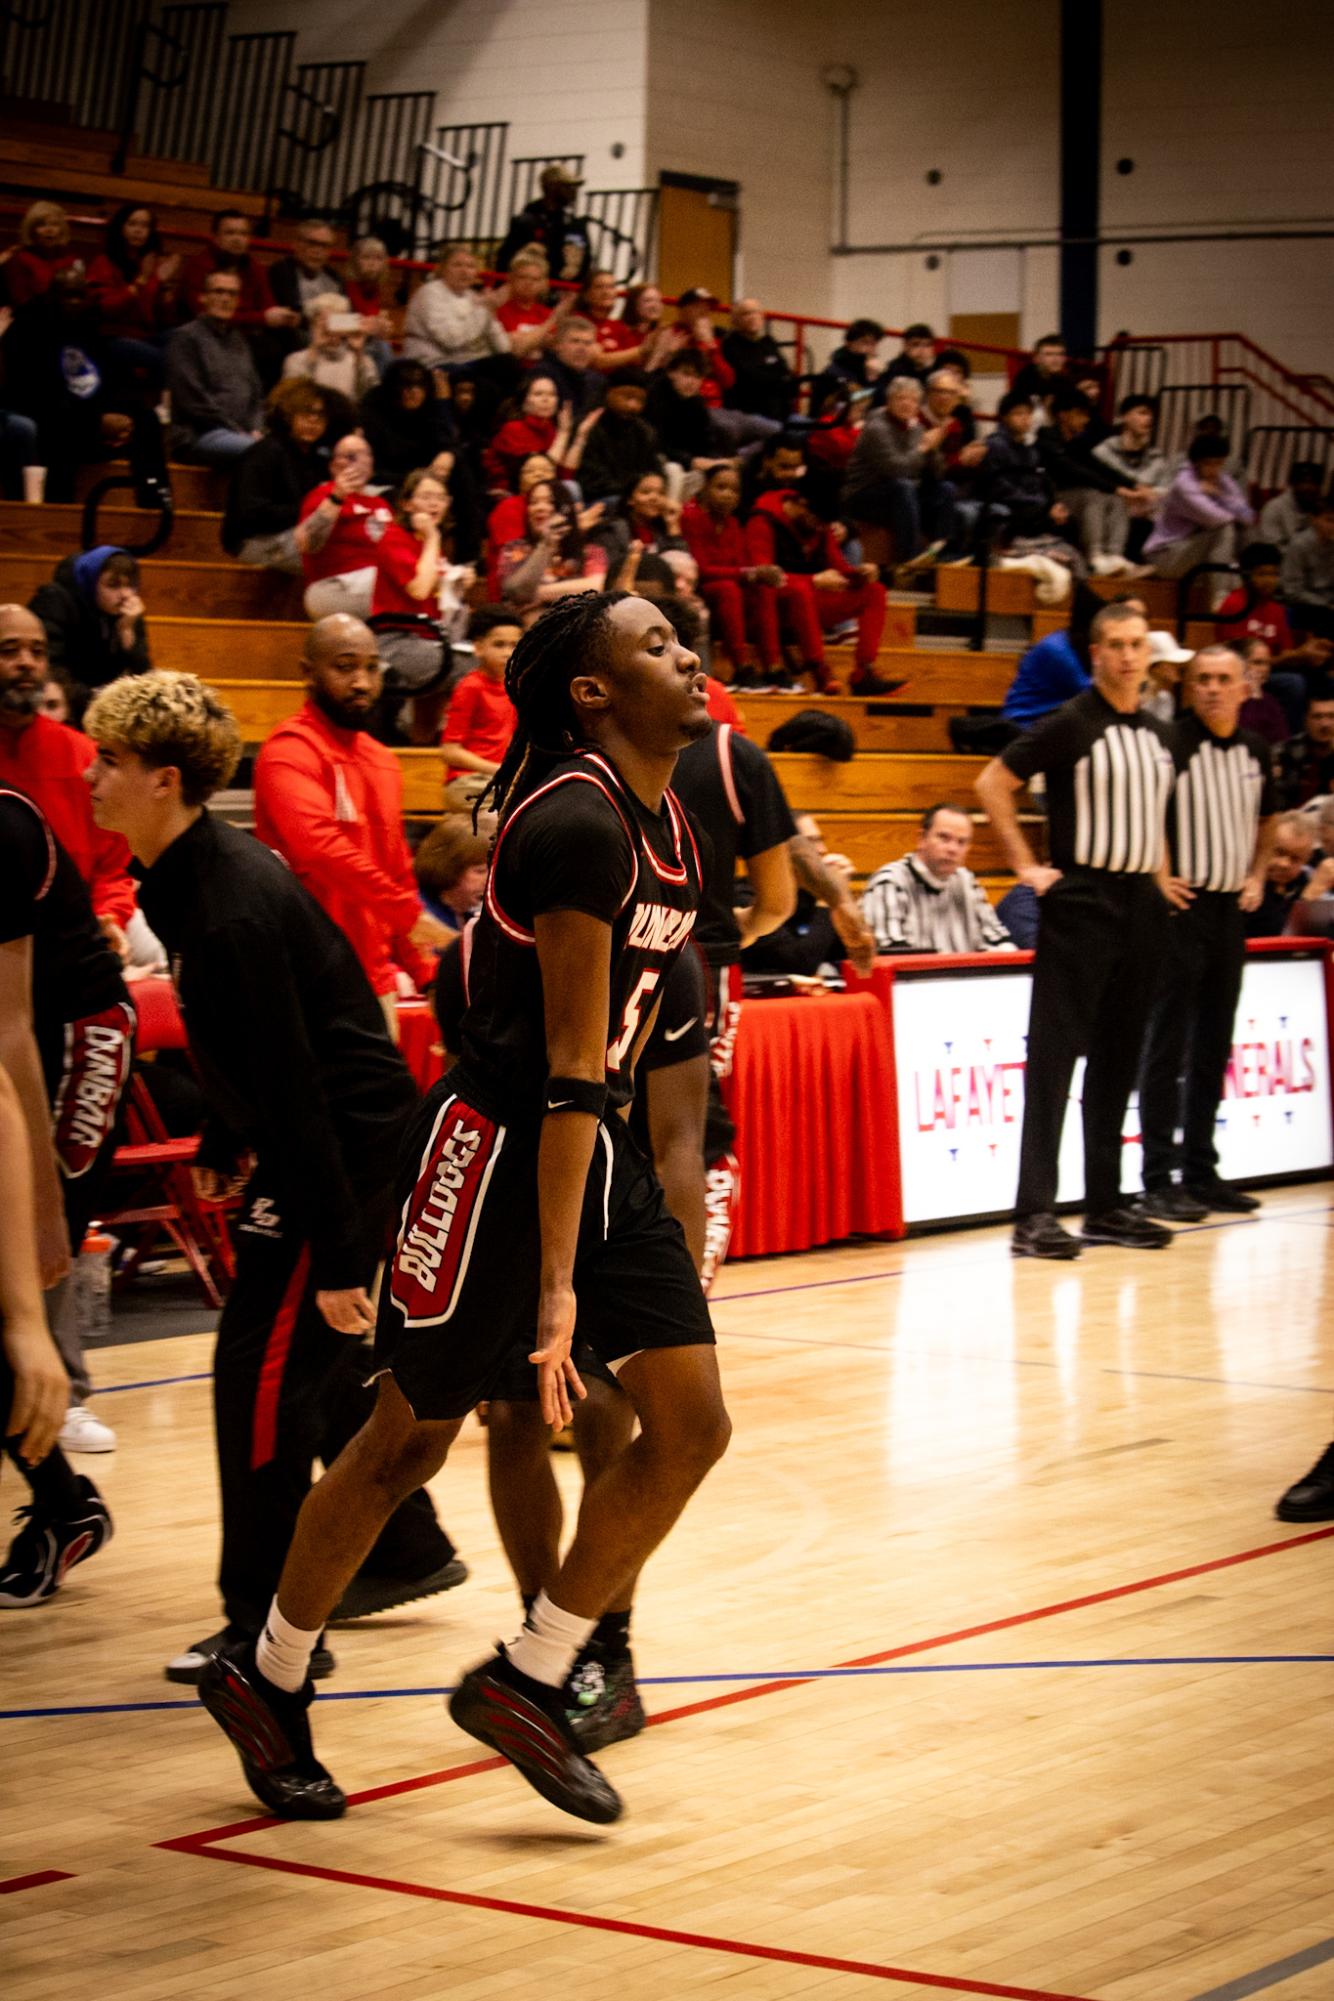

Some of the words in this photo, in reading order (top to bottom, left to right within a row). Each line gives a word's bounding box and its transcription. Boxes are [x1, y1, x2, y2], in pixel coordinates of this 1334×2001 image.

[605, 967, 660, 1074] 5
[68, 1025, 125, 1148] DUNBAR
[914, 1060, 1028, 1133] LAFAYE
[1223, 1037, 1316, 1100] NERALS
[398, 1119, 482, 1293] BULLDOGS
